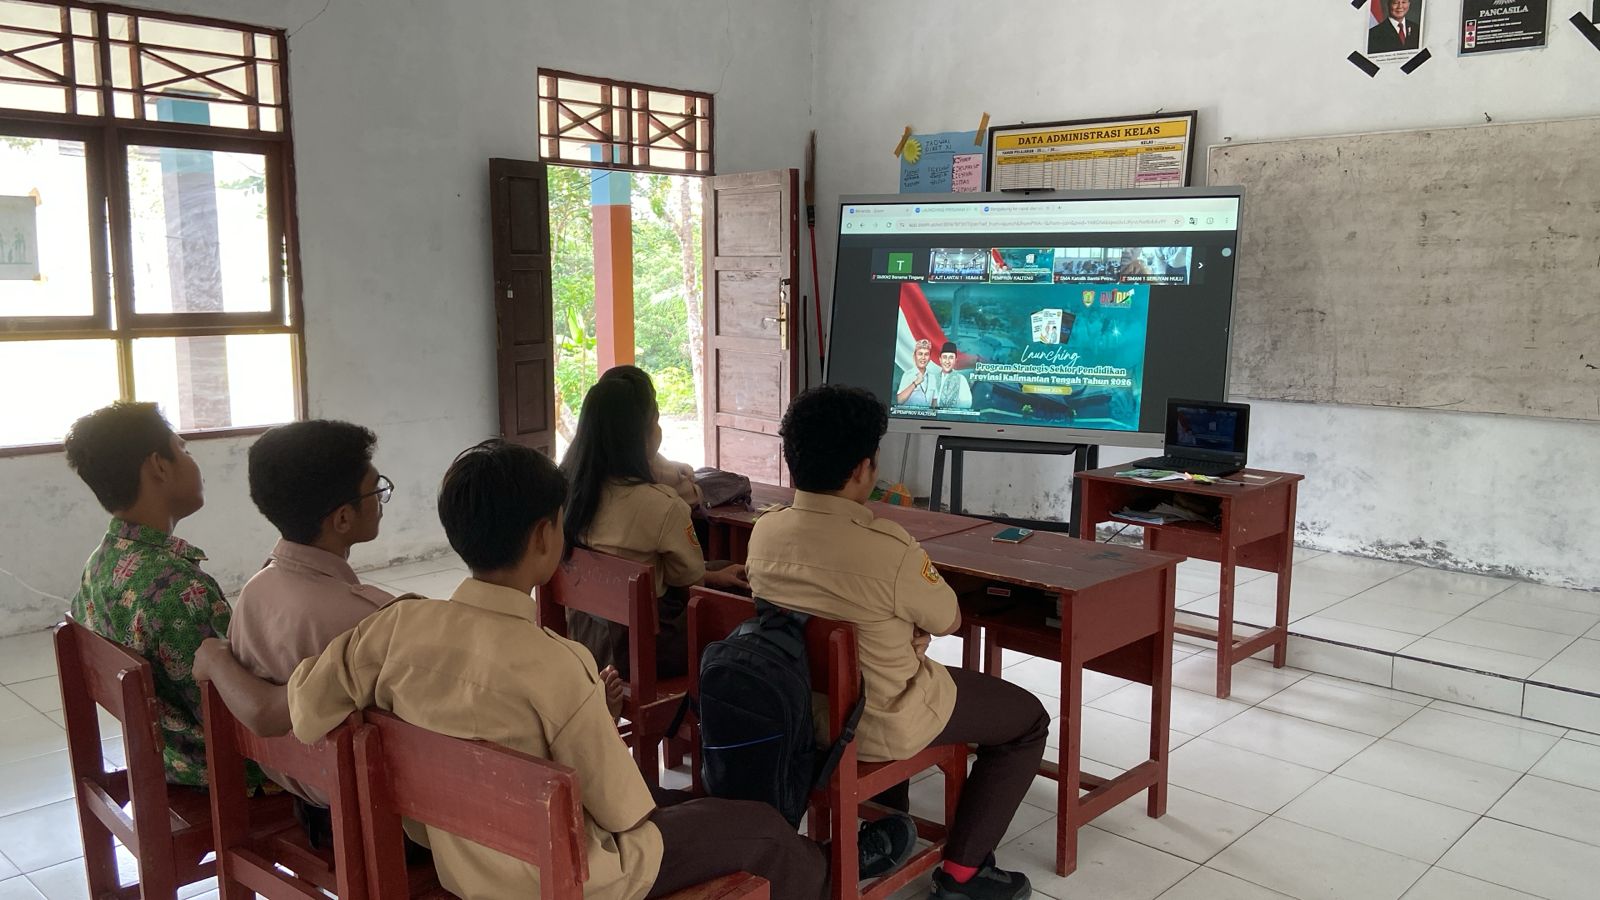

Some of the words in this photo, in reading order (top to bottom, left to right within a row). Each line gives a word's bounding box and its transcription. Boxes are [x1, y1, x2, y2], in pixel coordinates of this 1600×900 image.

[1479, 5, 1529, 17] PANCASILA
[1018, 135, 1044, 146] DATA
[1046, 129, 1121, 144] ADMINISTRASI
[1124, 126, 1161, 137] KELAS
[896, 260, 905, 271] T
[1020, 344, 1081, 367] Launching
[975, 362, 1012, 373] Program
[1012, 363, 1049, 375] Strategis
[1049, 363, 1078, 374] Sektor
[1078, 366, 1127, 376] Pendidikan
[969, 373, 1002, 382] Provinsi
[1003, 374, 1050, 383] Kalimantan
[1050, 376, 1081, 386] Tengah
[1082, 377, 1109, 385] Tahun
[1110, 378, 1132, 386] 2026
